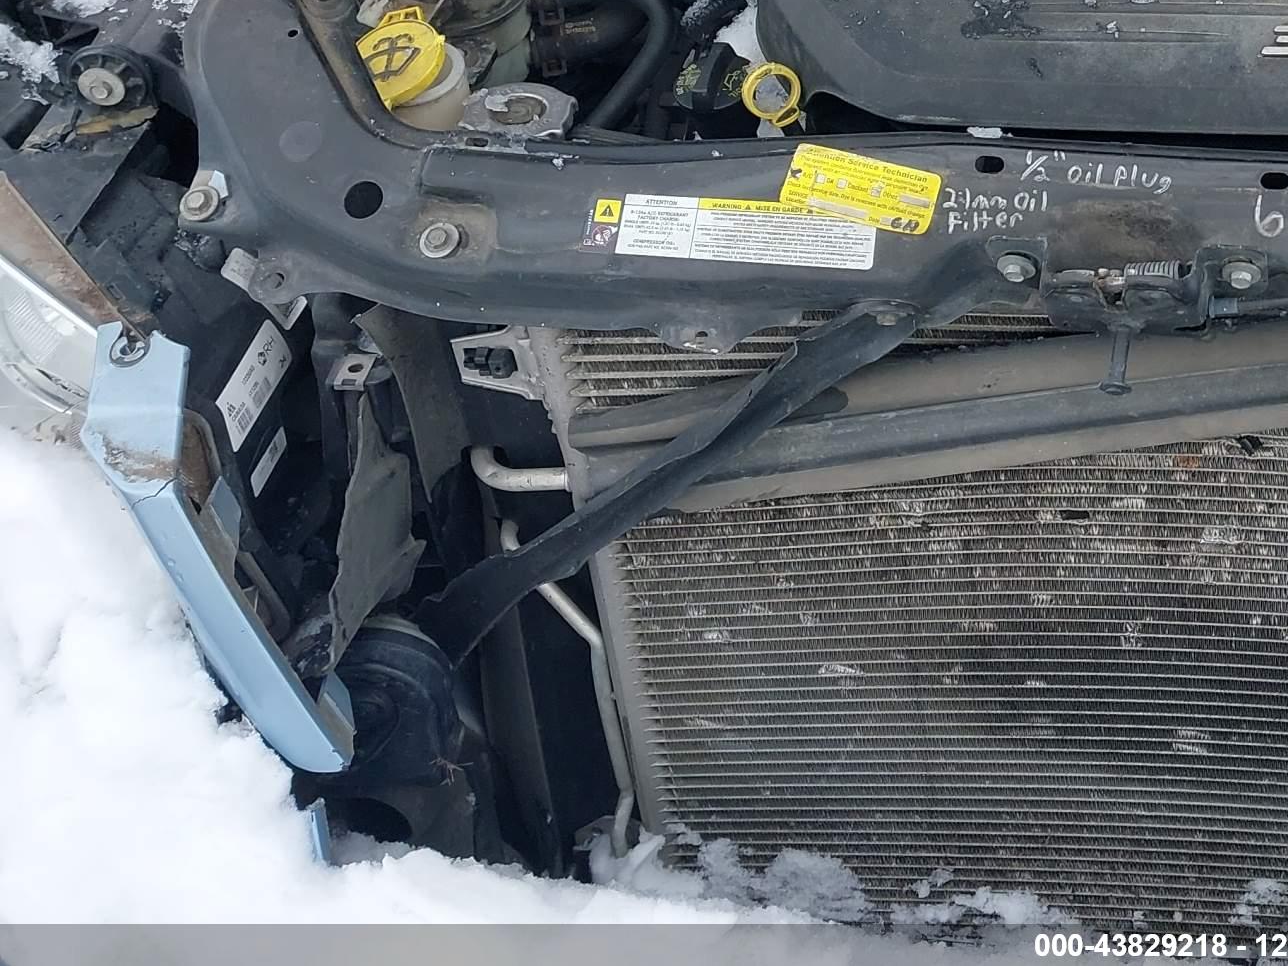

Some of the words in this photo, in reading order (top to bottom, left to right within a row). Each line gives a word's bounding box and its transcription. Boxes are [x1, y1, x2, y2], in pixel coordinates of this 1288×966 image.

[848, 158, 879, 172] Service
[882, 166, 928, 183] Technician
[712, 202, 742, 210] WARNING
[948, 210, 1023, 234] Filter
